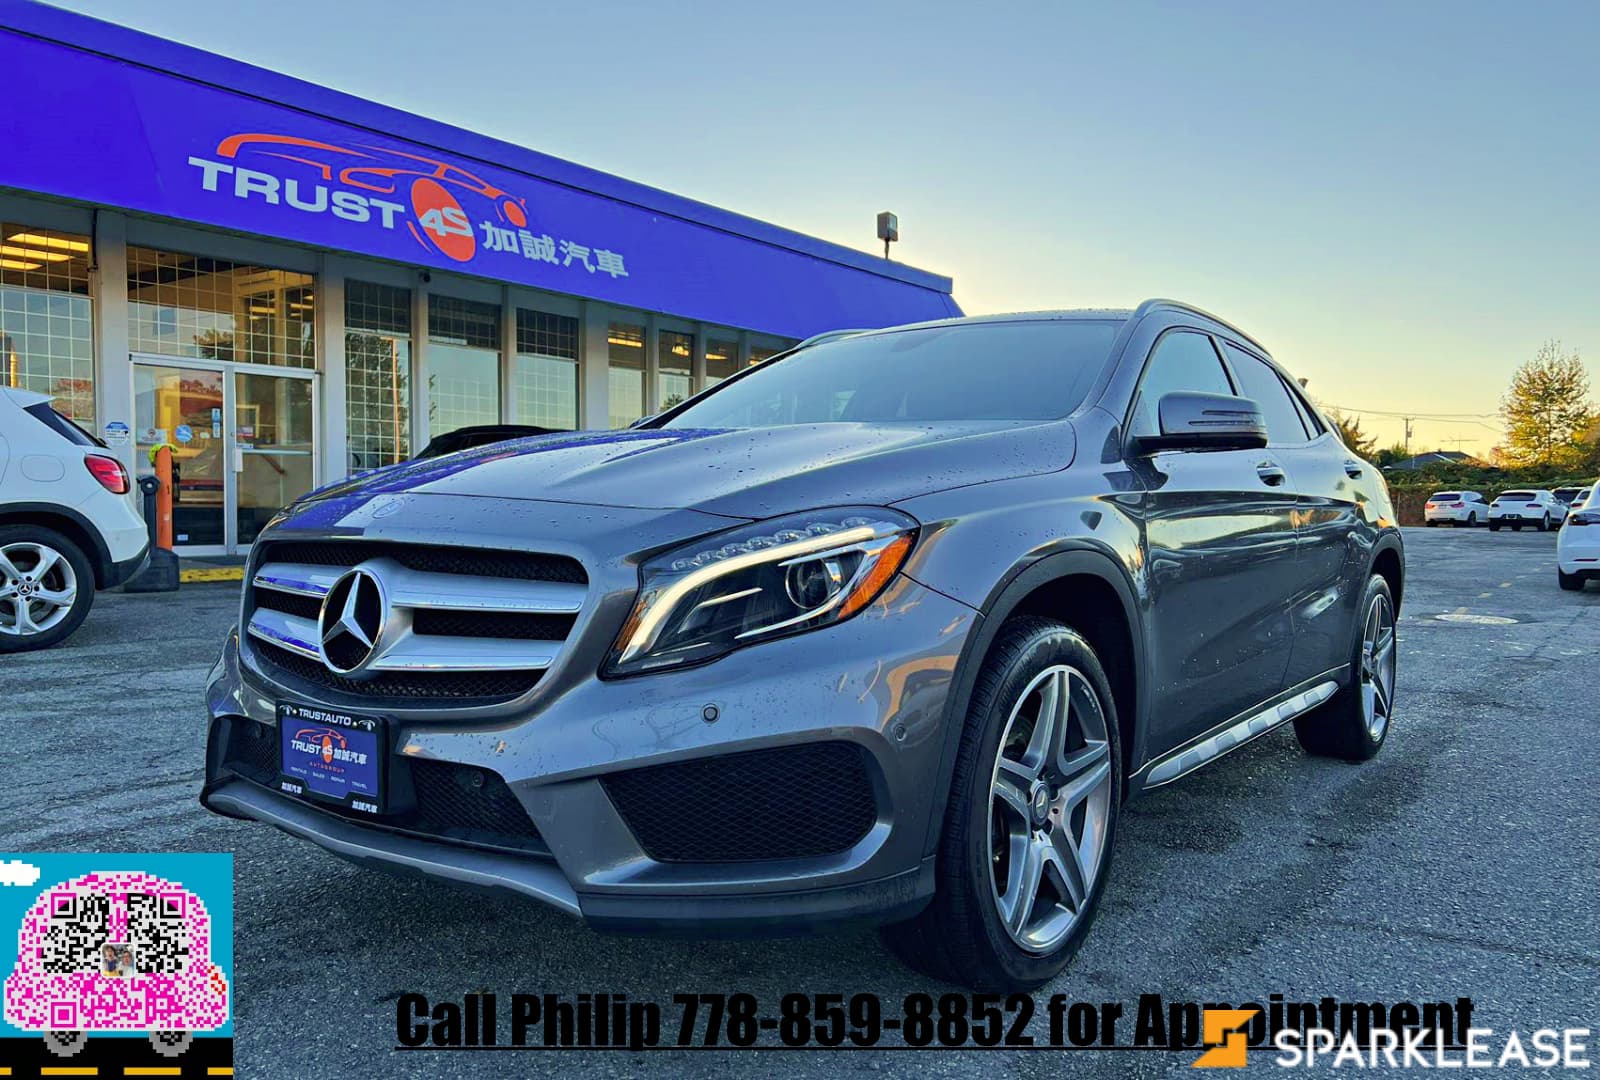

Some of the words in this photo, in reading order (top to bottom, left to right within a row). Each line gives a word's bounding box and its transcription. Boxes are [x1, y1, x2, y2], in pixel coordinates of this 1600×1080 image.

[188, 156, 405, 230] TRUST
[418, 206, 473, 238] 4S
[479, 220, 629, 278] 加誠汽車
[298, 708, 352, 726] TRUSTAUTO
[290, 739, 321, 755] TRUST
